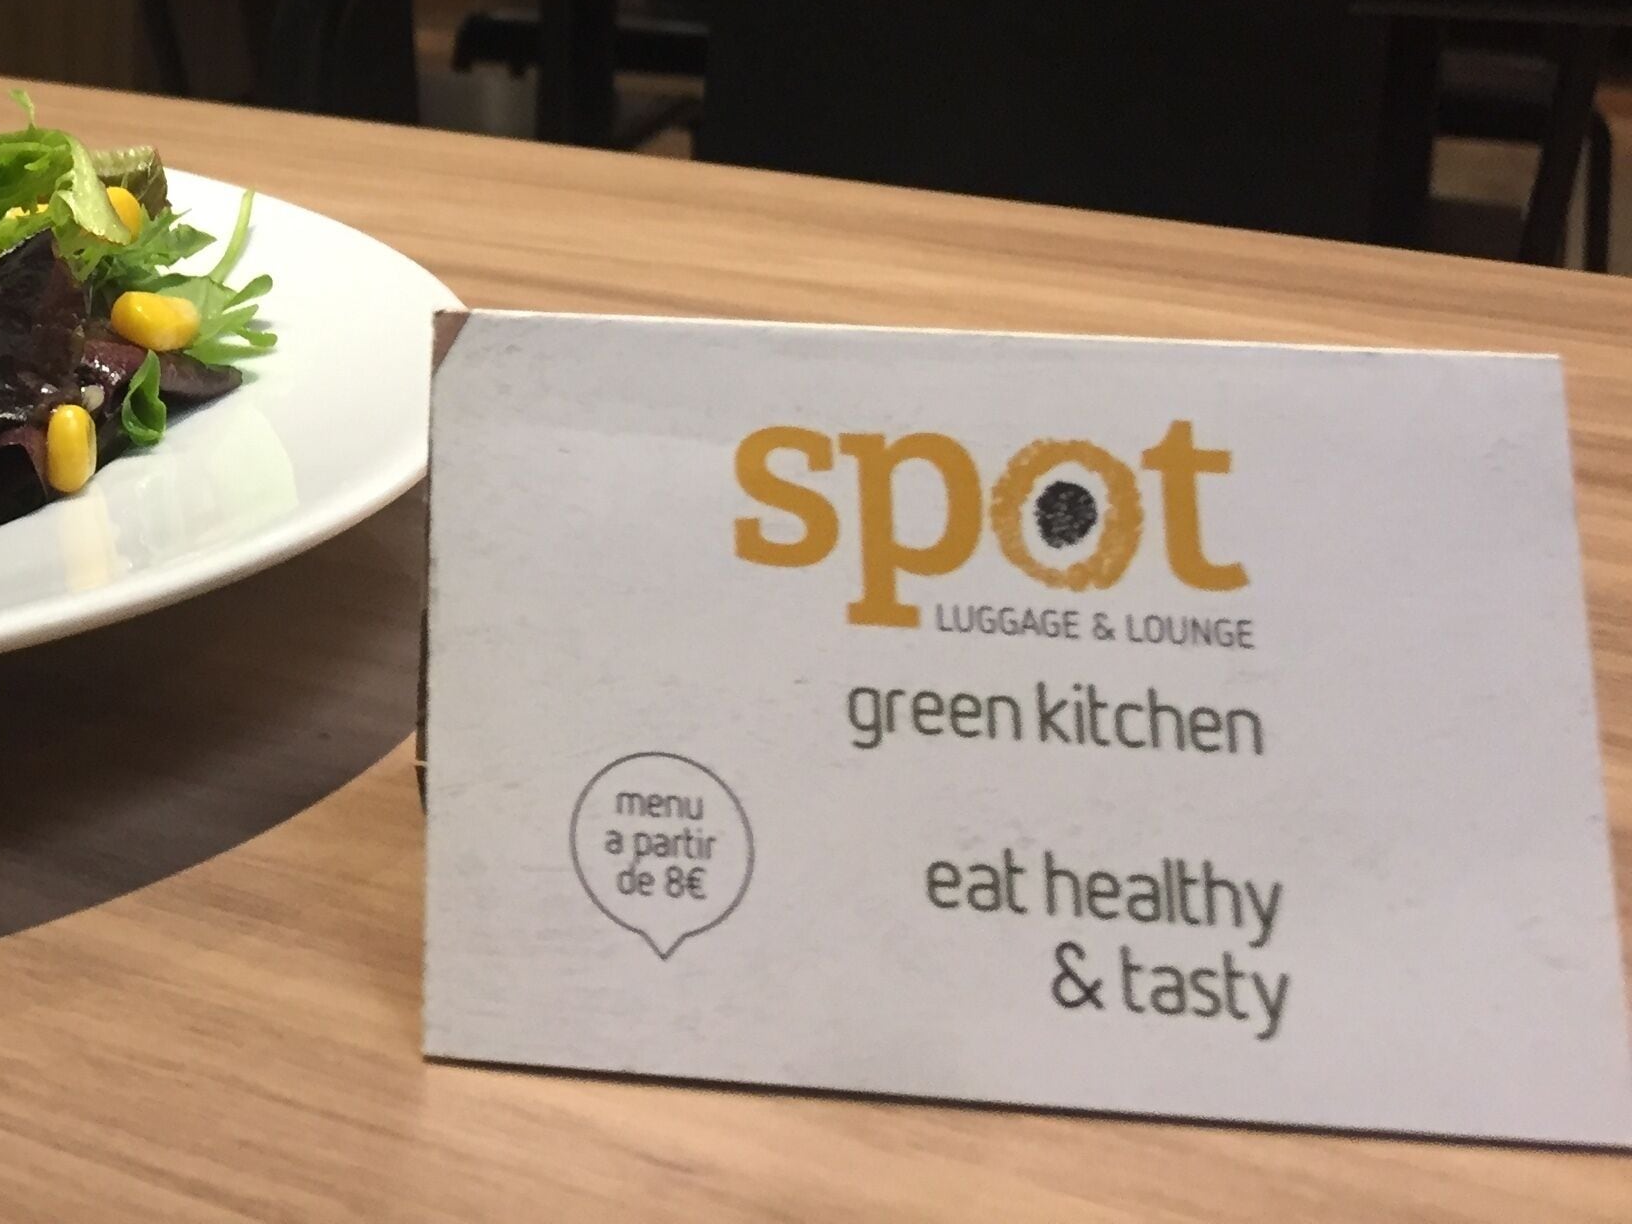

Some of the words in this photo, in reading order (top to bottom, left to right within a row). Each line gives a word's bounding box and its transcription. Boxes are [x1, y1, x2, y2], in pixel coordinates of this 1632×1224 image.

[733, 419, 1251, 630] spot
[935, 604, 1079, 640] LUGGAGE
[1092, 612, 1116, 641] &
[1126, 614, 1256, 650] LOUNGE
[847, 686, 1023, 751] green
[1036, 681, 1265, 756] kitchen
[615, 791, 705, 821] menu
[604, 829, 624, 855] a
[632, 827, 717, 864] partir
[616, 863, 656, 897] de
[665, 865, 707, 900] 8€
[925, 847, 1029, 915] eat
[1044, 850, 1284, 949] healthy
[1051, 940, 1106, 1010] &
[1119, 944, 1291, 1042] tasty
